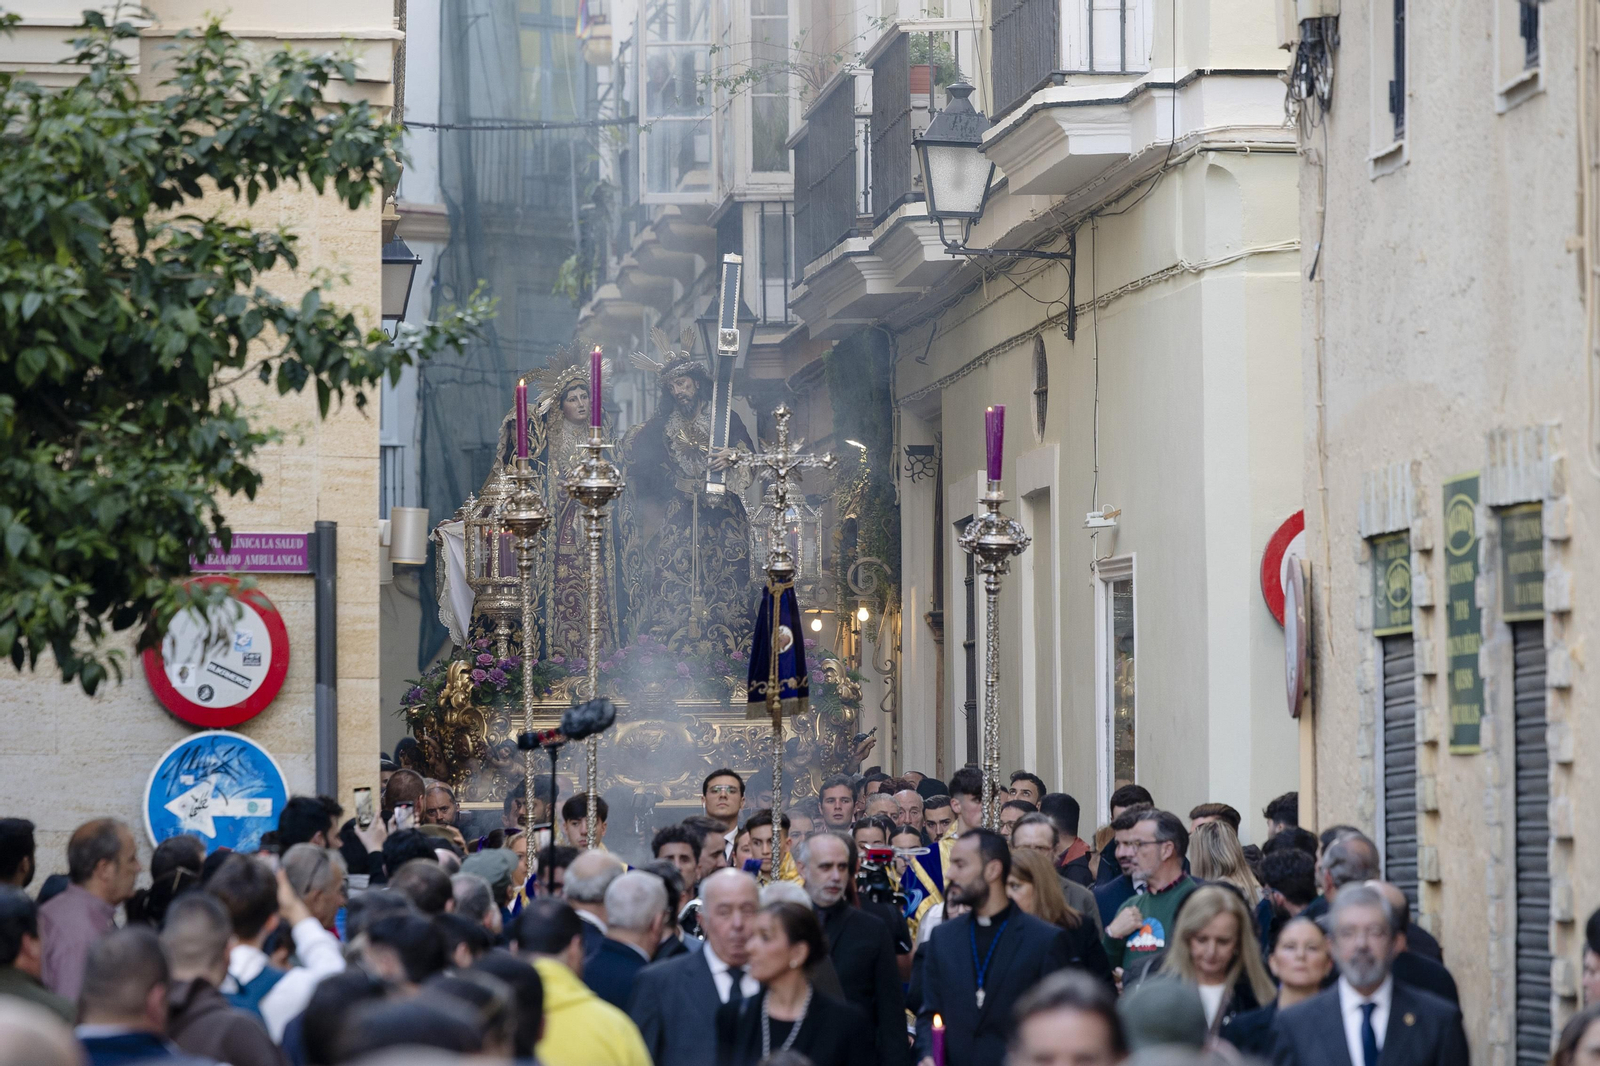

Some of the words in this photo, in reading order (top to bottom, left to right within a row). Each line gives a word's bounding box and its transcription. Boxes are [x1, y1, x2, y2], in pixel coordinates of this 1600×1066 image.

[227, 535, 259, 549] LÍNICA
[261, 538, 273, 549] LA
[275, 538, 304, 549] SALUD
[244, 554, 303, 566] AMBULANCIA
